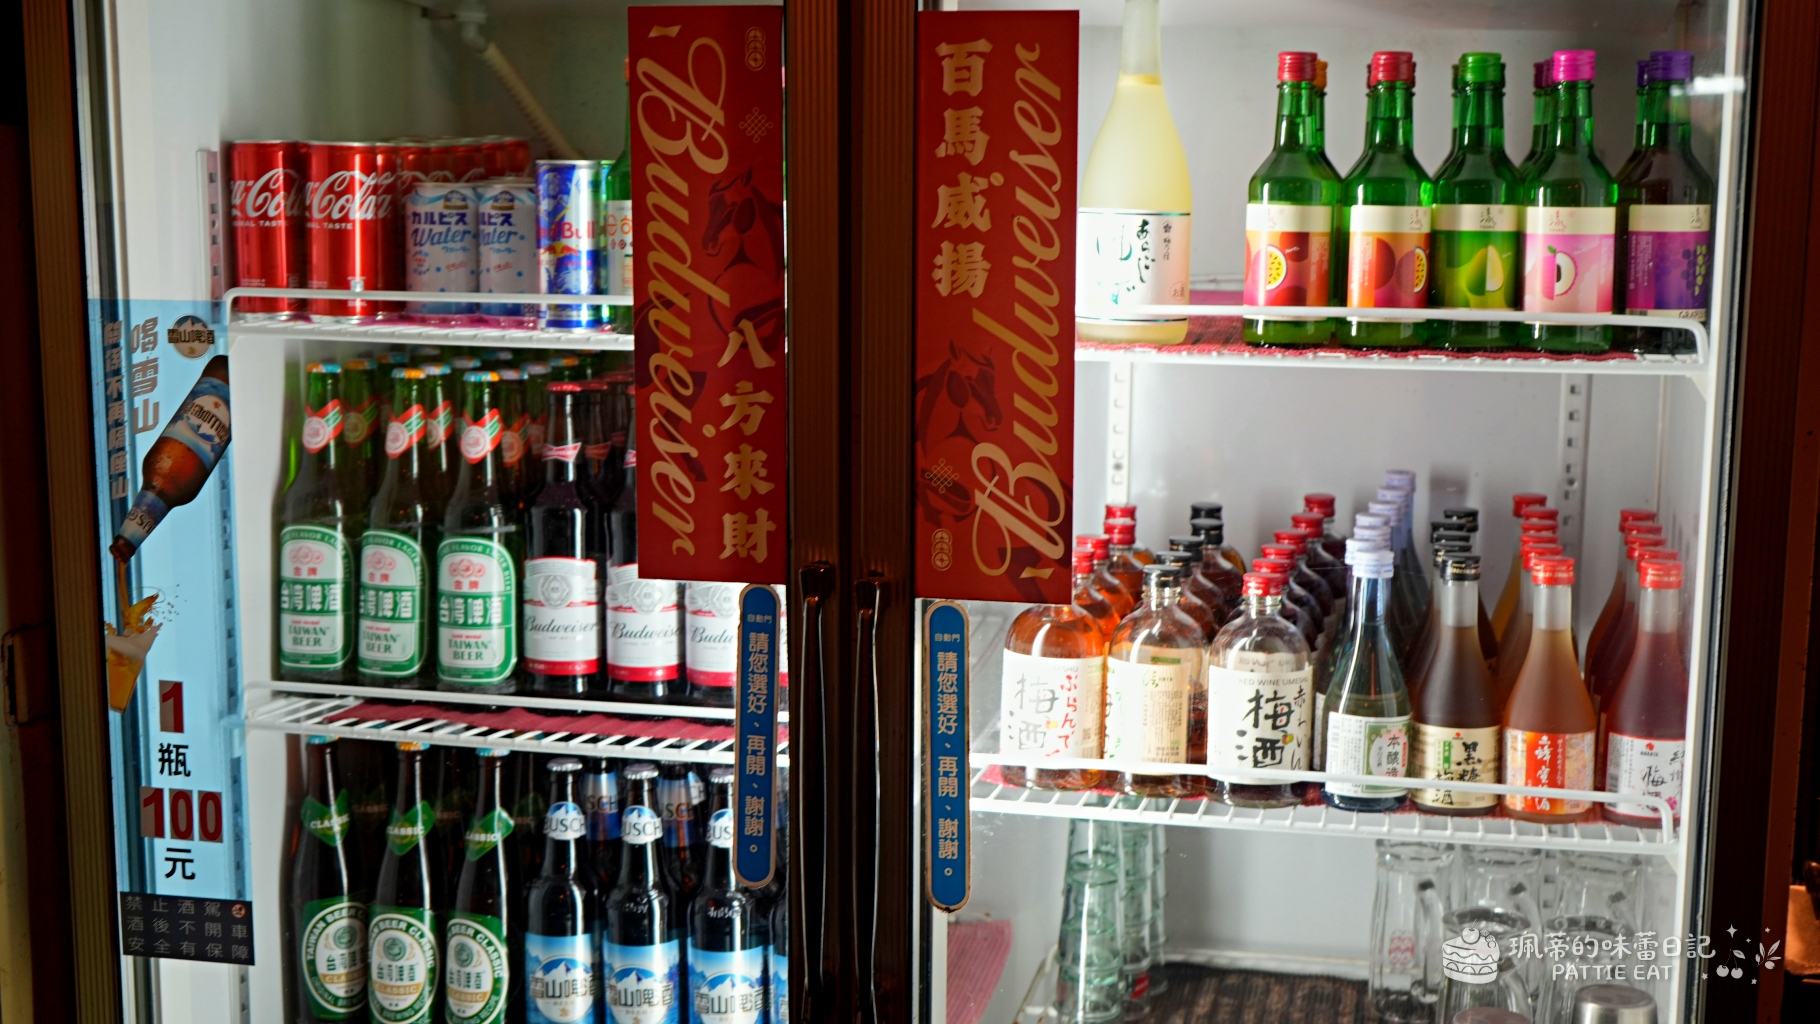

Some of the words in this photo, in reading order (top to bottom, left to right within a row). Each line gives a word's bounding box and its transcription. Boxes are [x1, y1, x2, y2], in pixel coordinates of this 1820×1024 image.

[931, 38, 993, 298] 百馬威揚
[412, 211, 468, 225] カルピス
[412, 227, 471, 247] Water
[636, 37, 730, 557] Budweiser
[971, 42, 1065, 576] Budweiser
[167, 328, 215, 345] 雪山啤酒
[131, 316, 160, 435] 喝雪山
[717, 319, 776, 563] 八方來財
[293, 566, 317, 577] 金牌
[368, 571, 390, 583] 金牌
[454, 579, 479, 590] 金牌
[524, 615, 598, 633] Budweiser
[747, 614, 772, 624] 自動門
[288, 625, 327, 637] TAIWAN
[292, 636, 322, 647] BEER
[363, 630, 397, 643] TAIWAN
[934, 632, 960, 643] 自動門
[365, 642, 392, 654] BEER
[448, 638, 488, 650] TAIWAN
[453, 650, 483, 661] BEER
[1257, 678, 1280, 686] WINE
[161, 682, 184, 734] 1
[1008, 672, 1060, 750] 梅酒
[1235, 688, 1295, 768] 梅酒
[745, 632, 769, 853] 請您選好、再開、謝謝。
[158, 743, 191, 777] 瓶
[937, 651, 959, 877] 請您選好、再開、謝謝。
[142, 788, 223, 842] 100
[164, 848, 196, 880] 元
[125, 895, 222, 917] 禁止酒駕
[127, 916, 249, 939] 酒後不開車
[381, 920, 408, 930] BEER
[128, 937, 249, 960] 安全有保障
[307, 920, 327, 960] TAIWAN
[476, 934, 503, 978] CLASSIC
[607, 981, 674, 1007] 雪山啤酒
